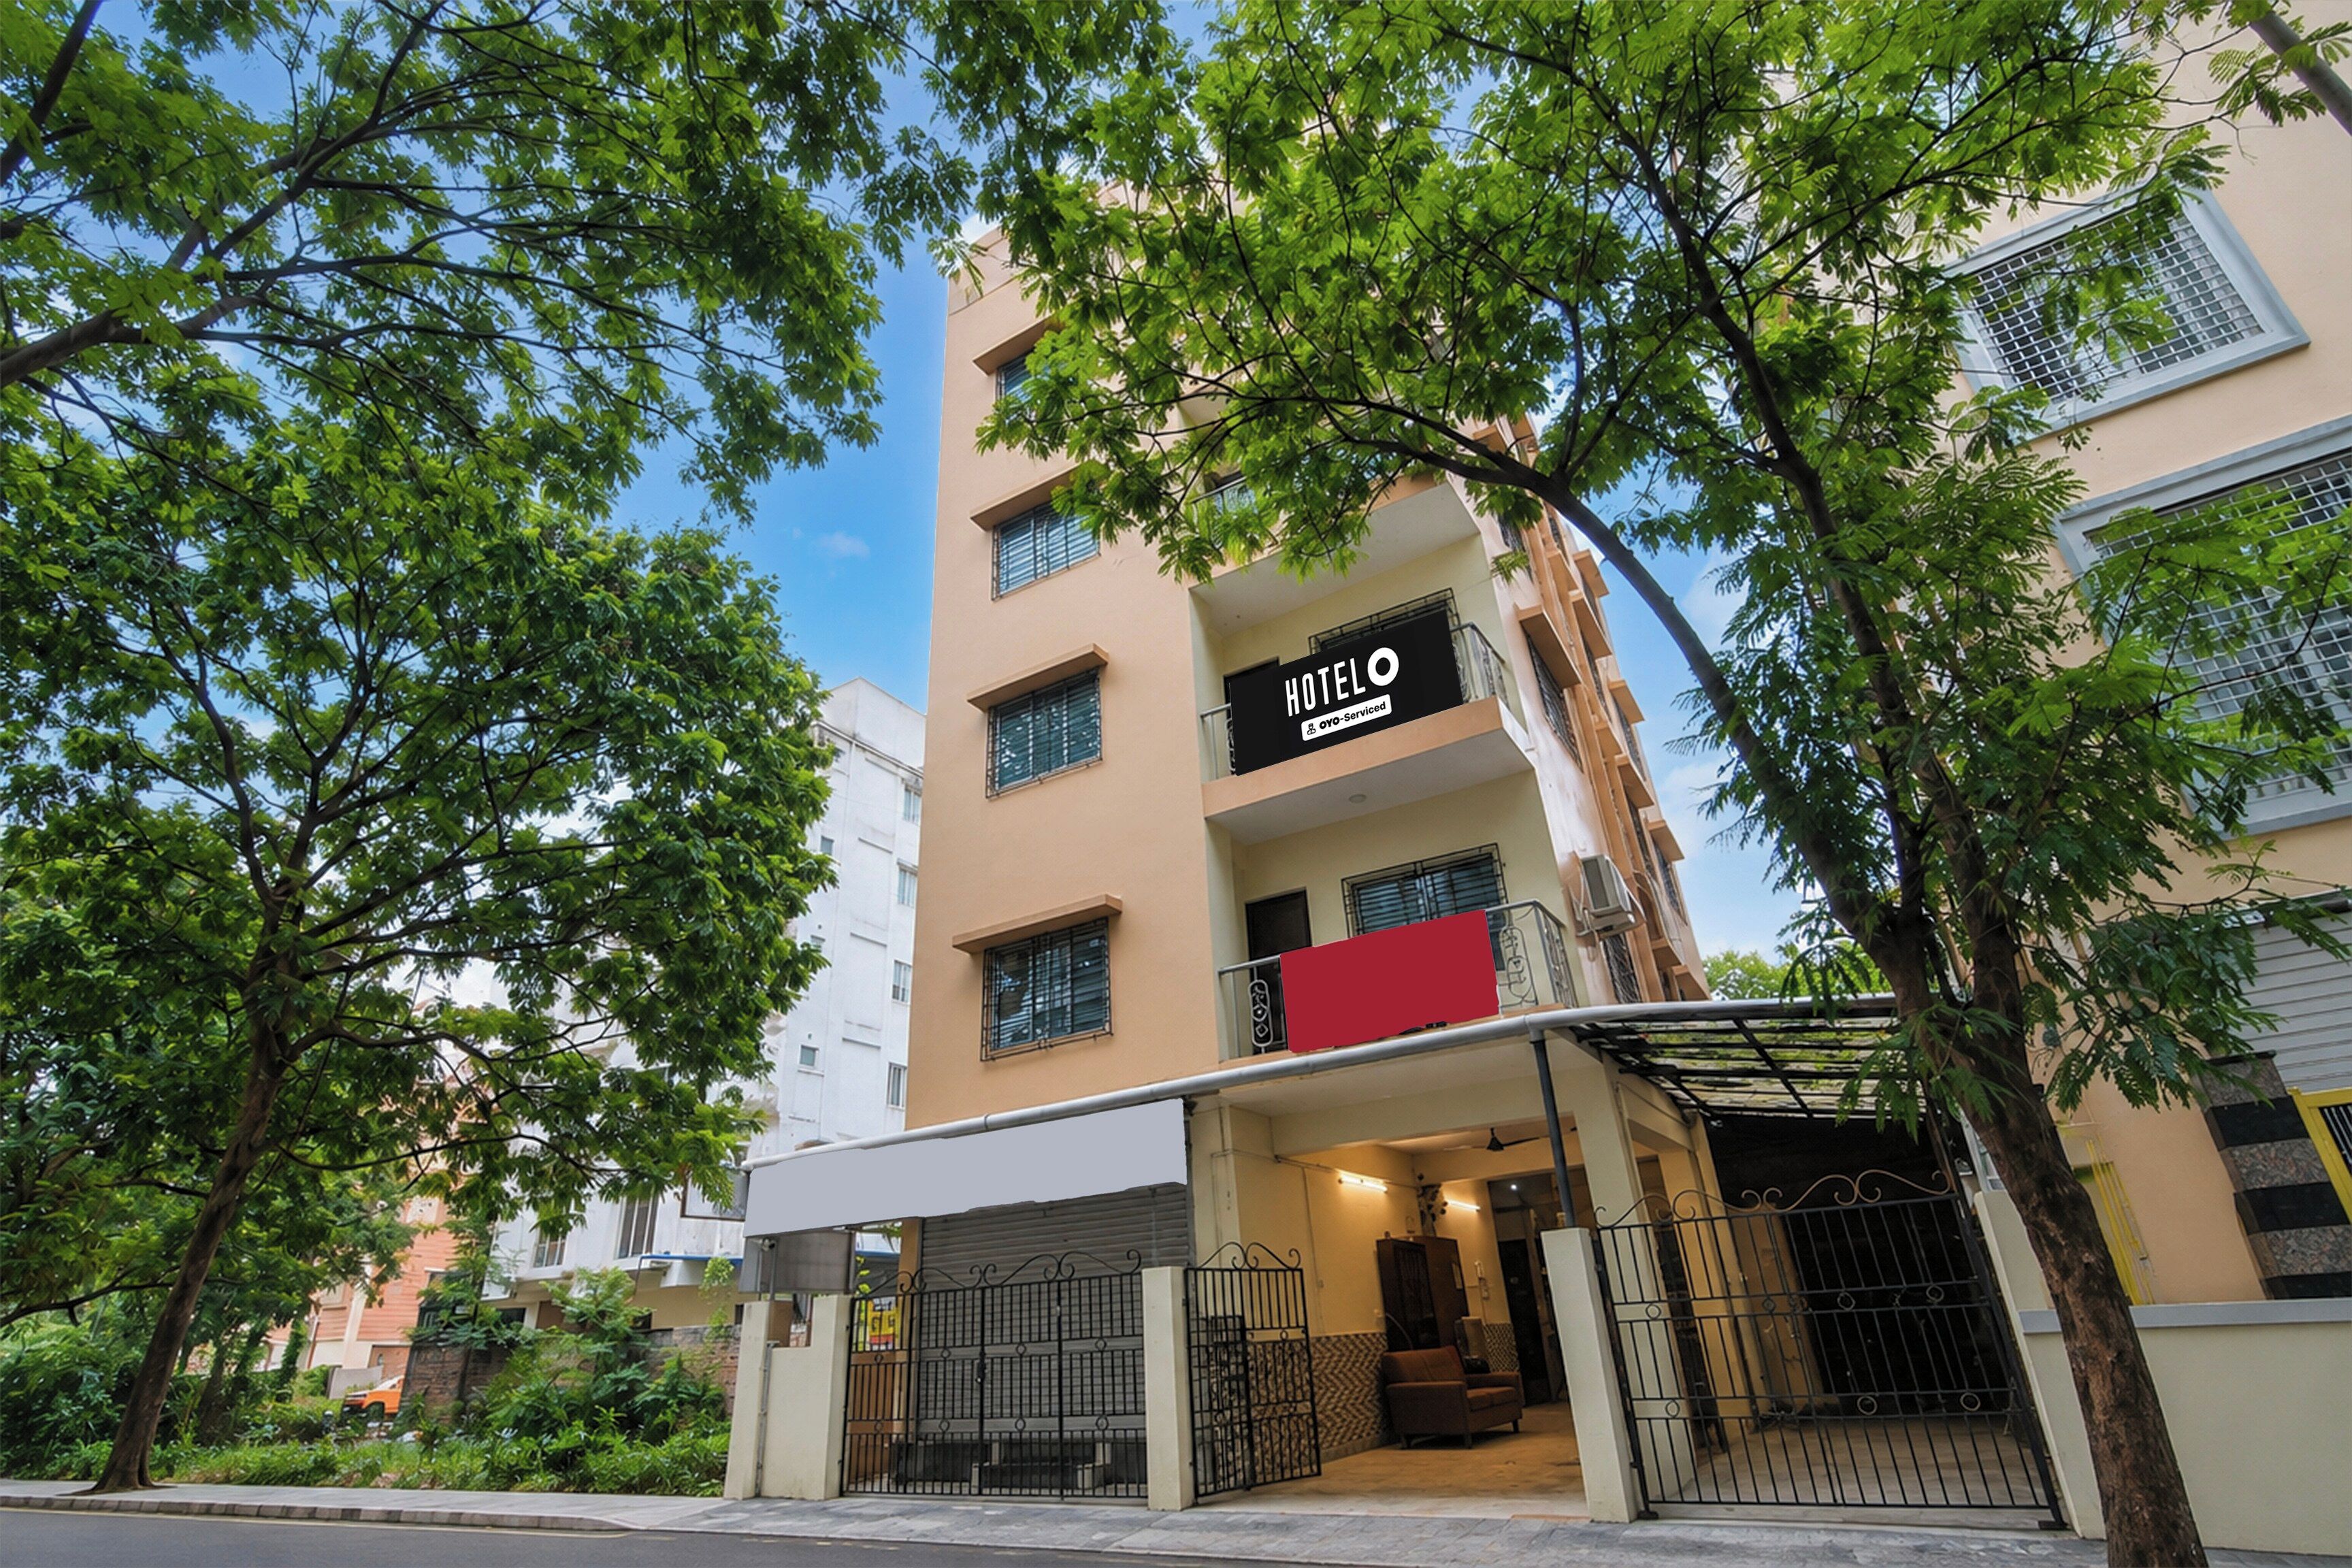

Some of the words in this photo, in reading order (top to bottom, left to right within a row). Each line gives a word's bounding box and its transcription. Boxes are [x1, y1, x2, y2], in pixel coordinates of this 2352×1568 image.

[1285, 657, 1366, 717] HOTEL
[1367, 647, 1399, 687] O
[1319, 701, 1386, 730] OYO-Serviced
